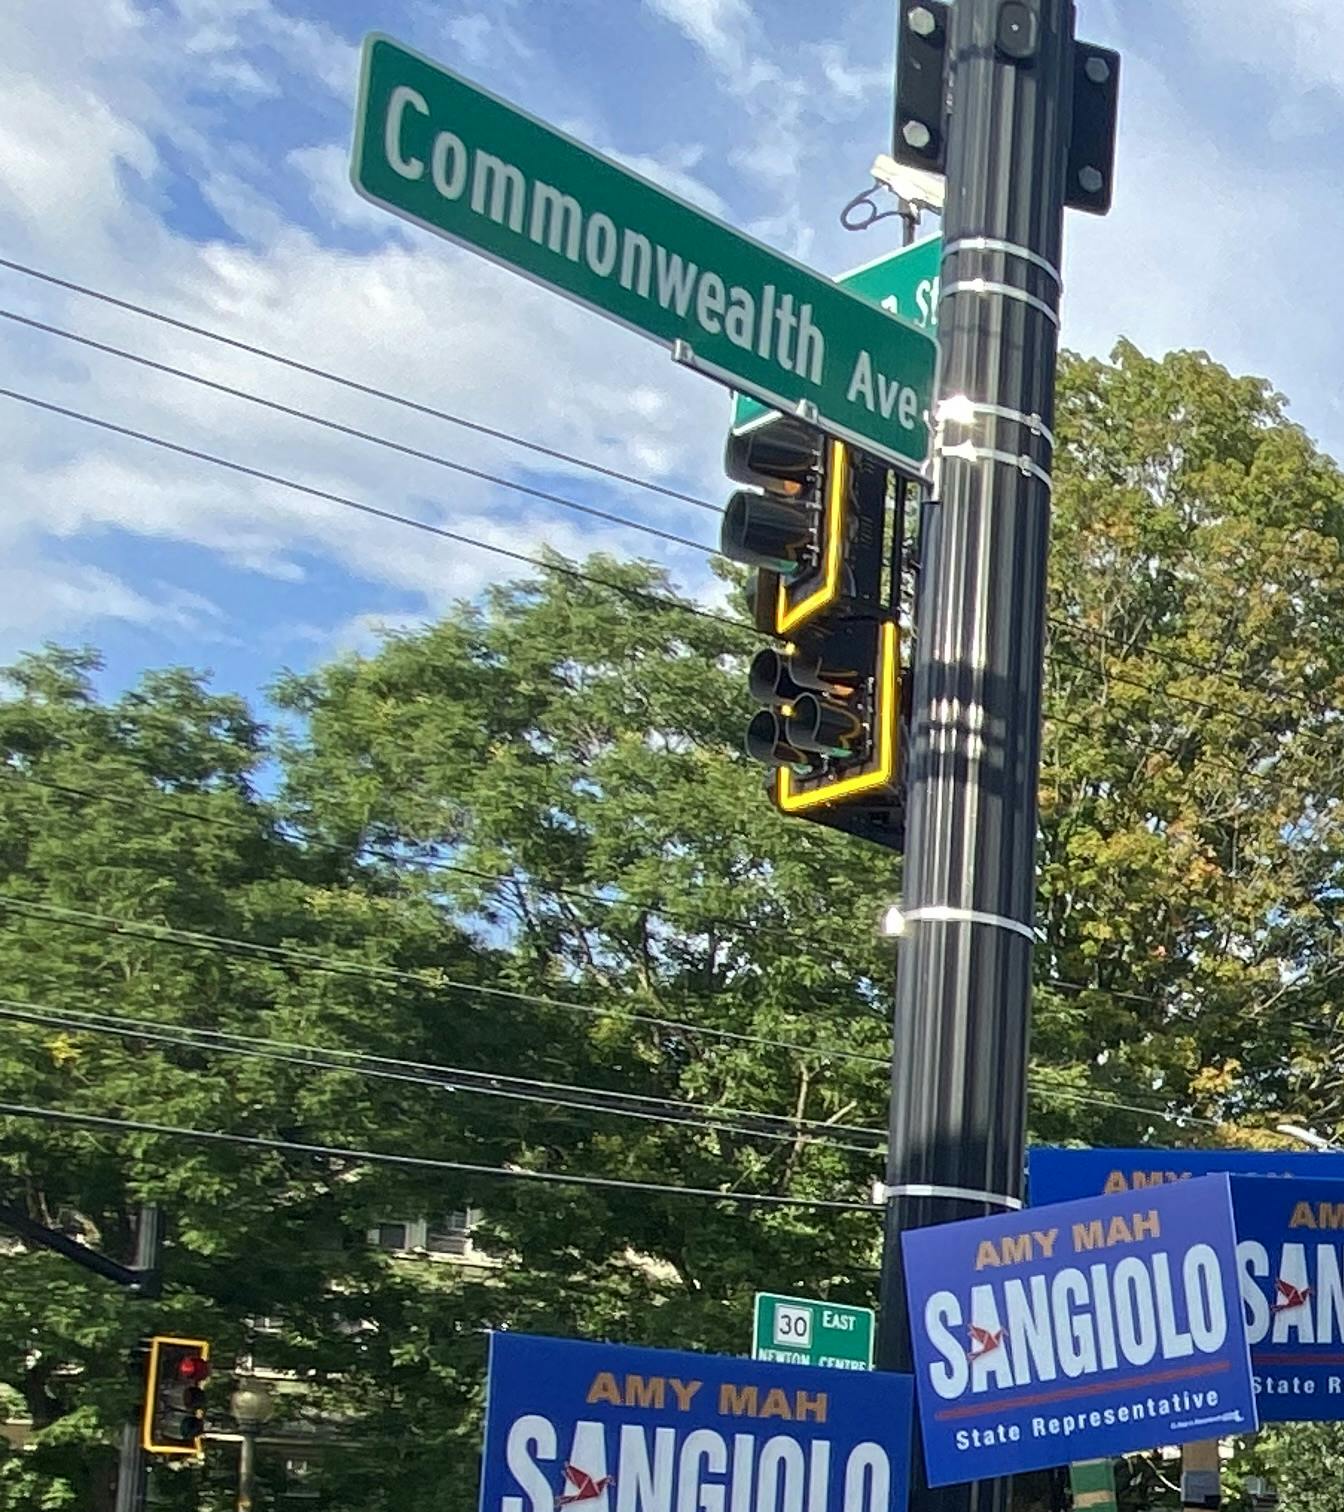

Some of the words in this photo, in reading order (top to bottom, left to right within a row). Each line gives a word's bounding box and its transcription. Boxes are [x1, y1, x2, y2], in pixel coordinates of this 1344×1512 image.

[385, 86, 824, 386] Commonwealth
[847, 351, 918, 431] Ave
[974, 1229, 1057, 1270] AMY
[1073, 1210, 1160, 1253] MAH
[779, 1314, 807, 1337] 30
[822, 1310, 857, 1331] EAST
[925, 1244, 1227, 1399] SANGIOLO
[587, 1372, 703, 1411] AMY
[719, 1383, 828, 1424] MAH
[1251, 1376, 1315, 1393] State
[956, 1423, 1020, 1451] State
[1032, 1390, 1219, 1439] Representative
